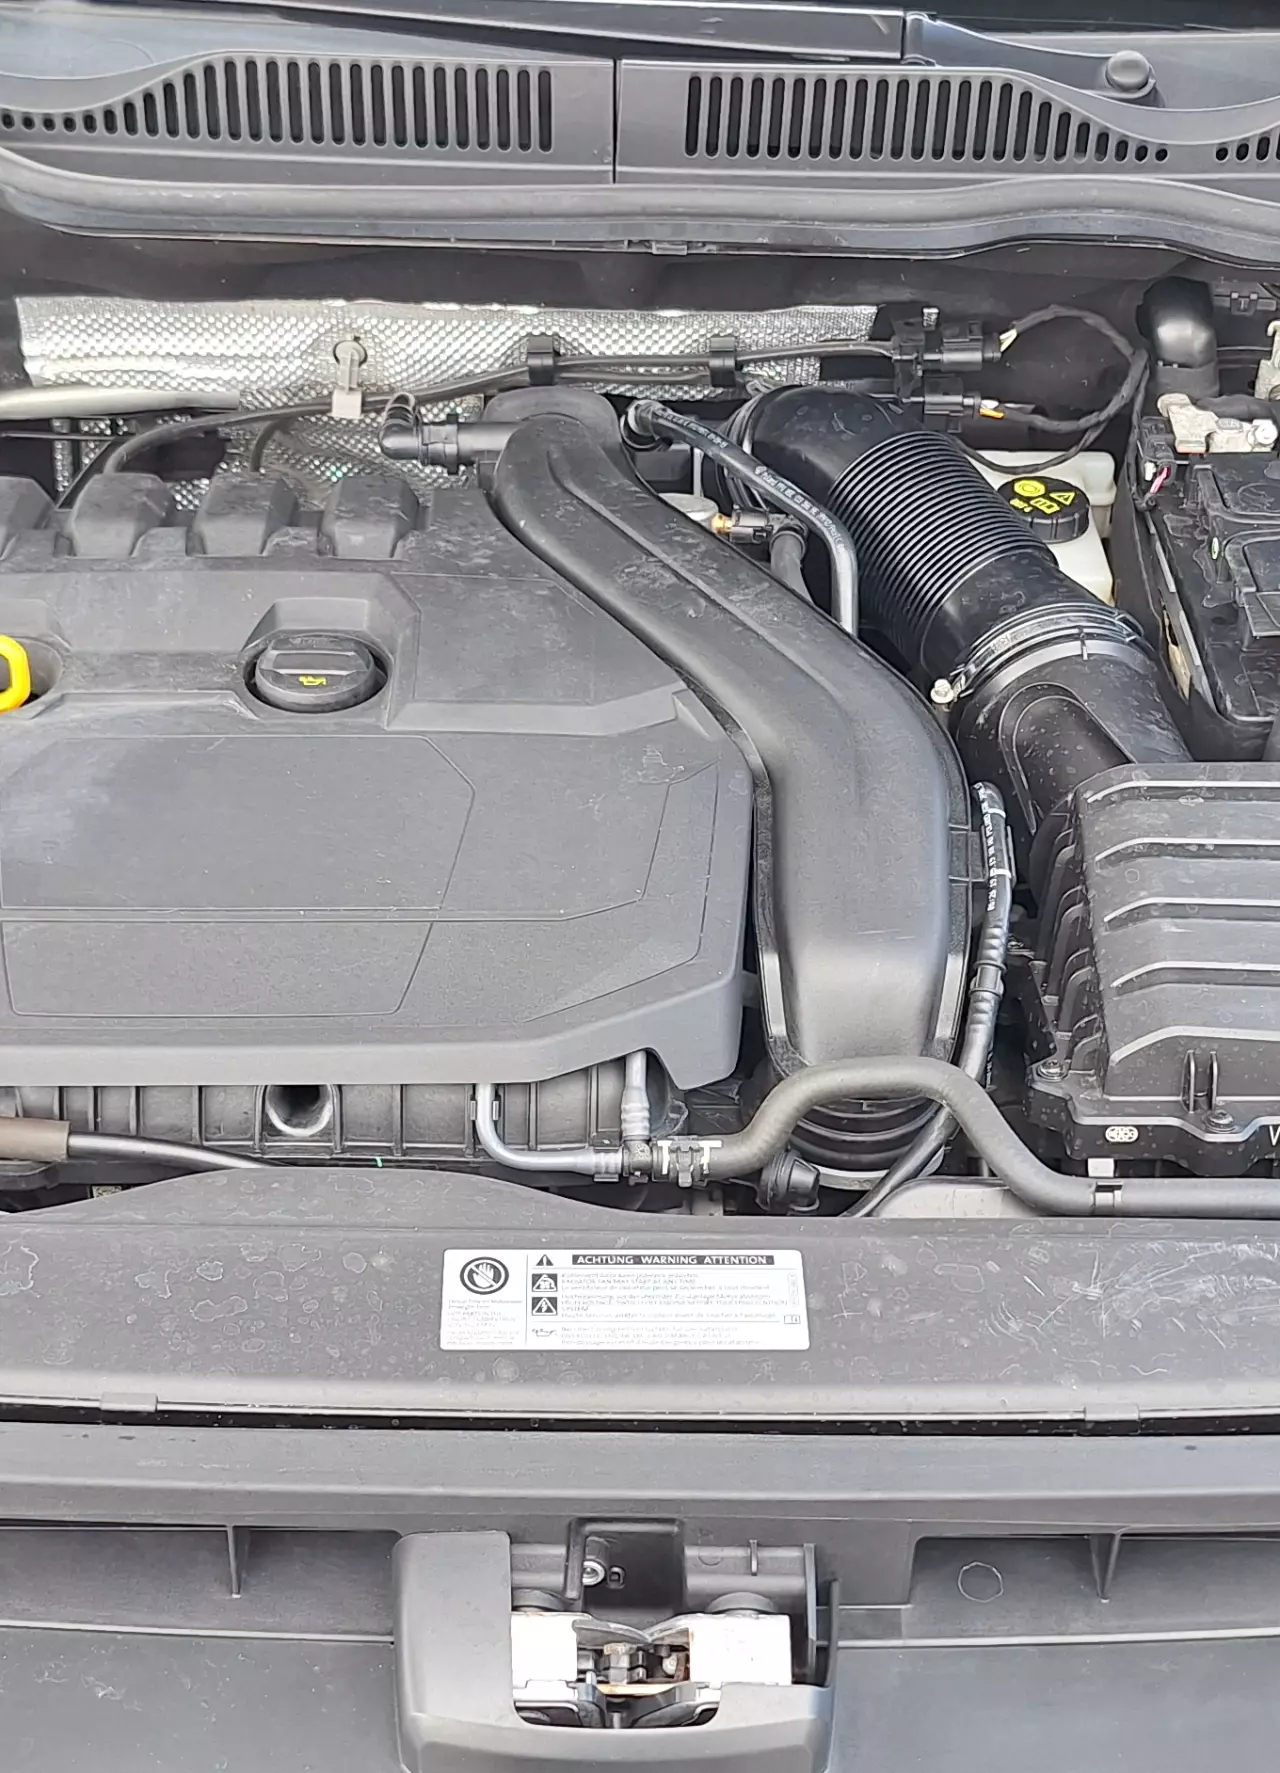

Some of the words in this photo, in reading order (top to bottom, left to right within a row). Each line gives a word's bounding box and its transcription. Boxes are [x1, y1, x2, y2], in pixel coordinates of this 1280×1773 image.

[576, 1255, 634, 1265] ACHTUNG
[640, 1255, 698, 1265] WARNING
[703, 1255, 768, 1265] ATTENTION
